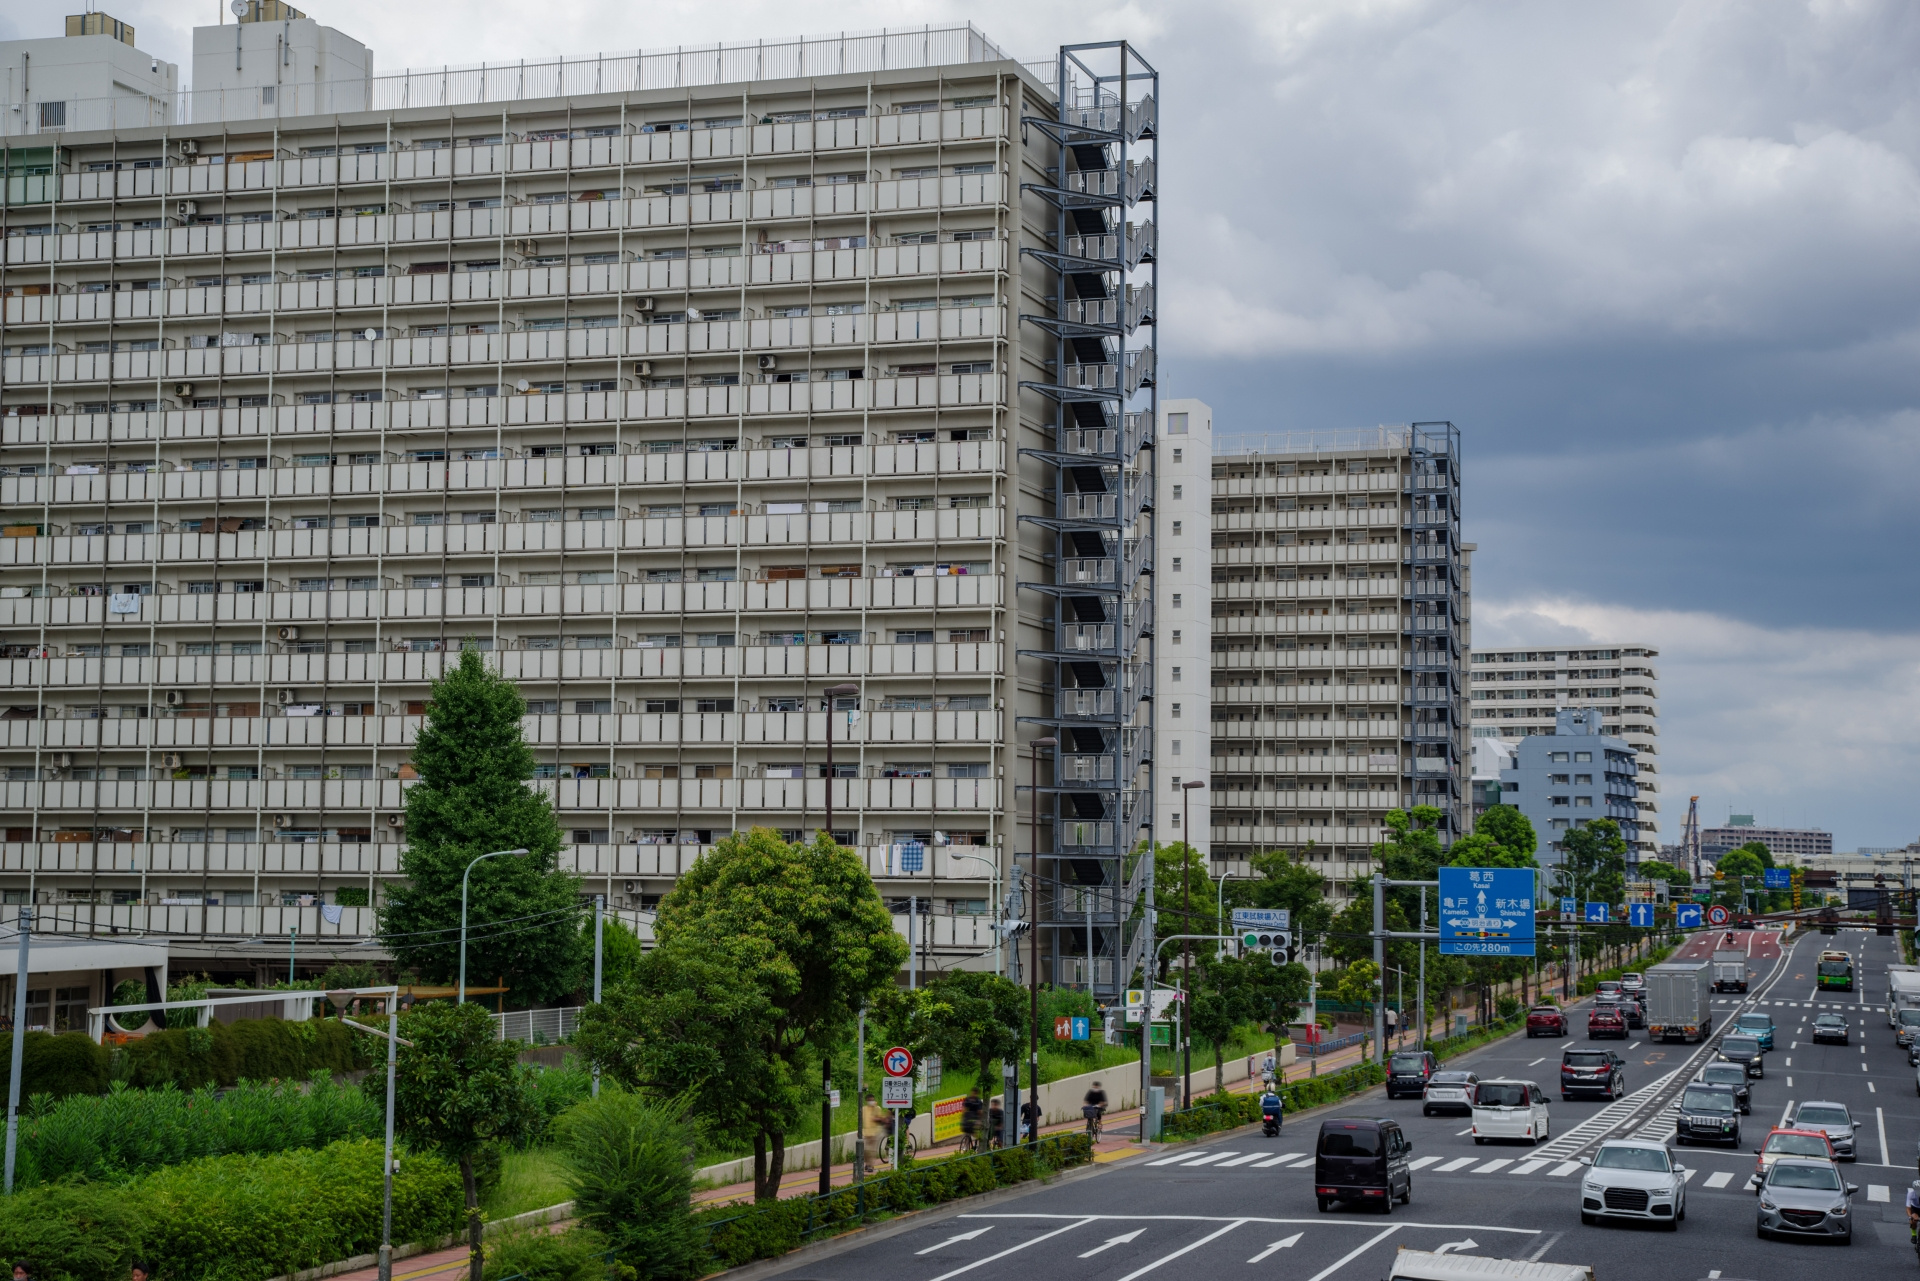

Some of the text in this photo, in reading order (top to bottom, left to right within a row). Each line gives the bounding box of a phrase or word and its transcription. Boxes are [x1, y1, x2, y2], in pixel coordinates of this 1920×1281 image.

[1443, 897, 1468, 908] 亀戸
[1495, 898, 1531, 910] 新木場
